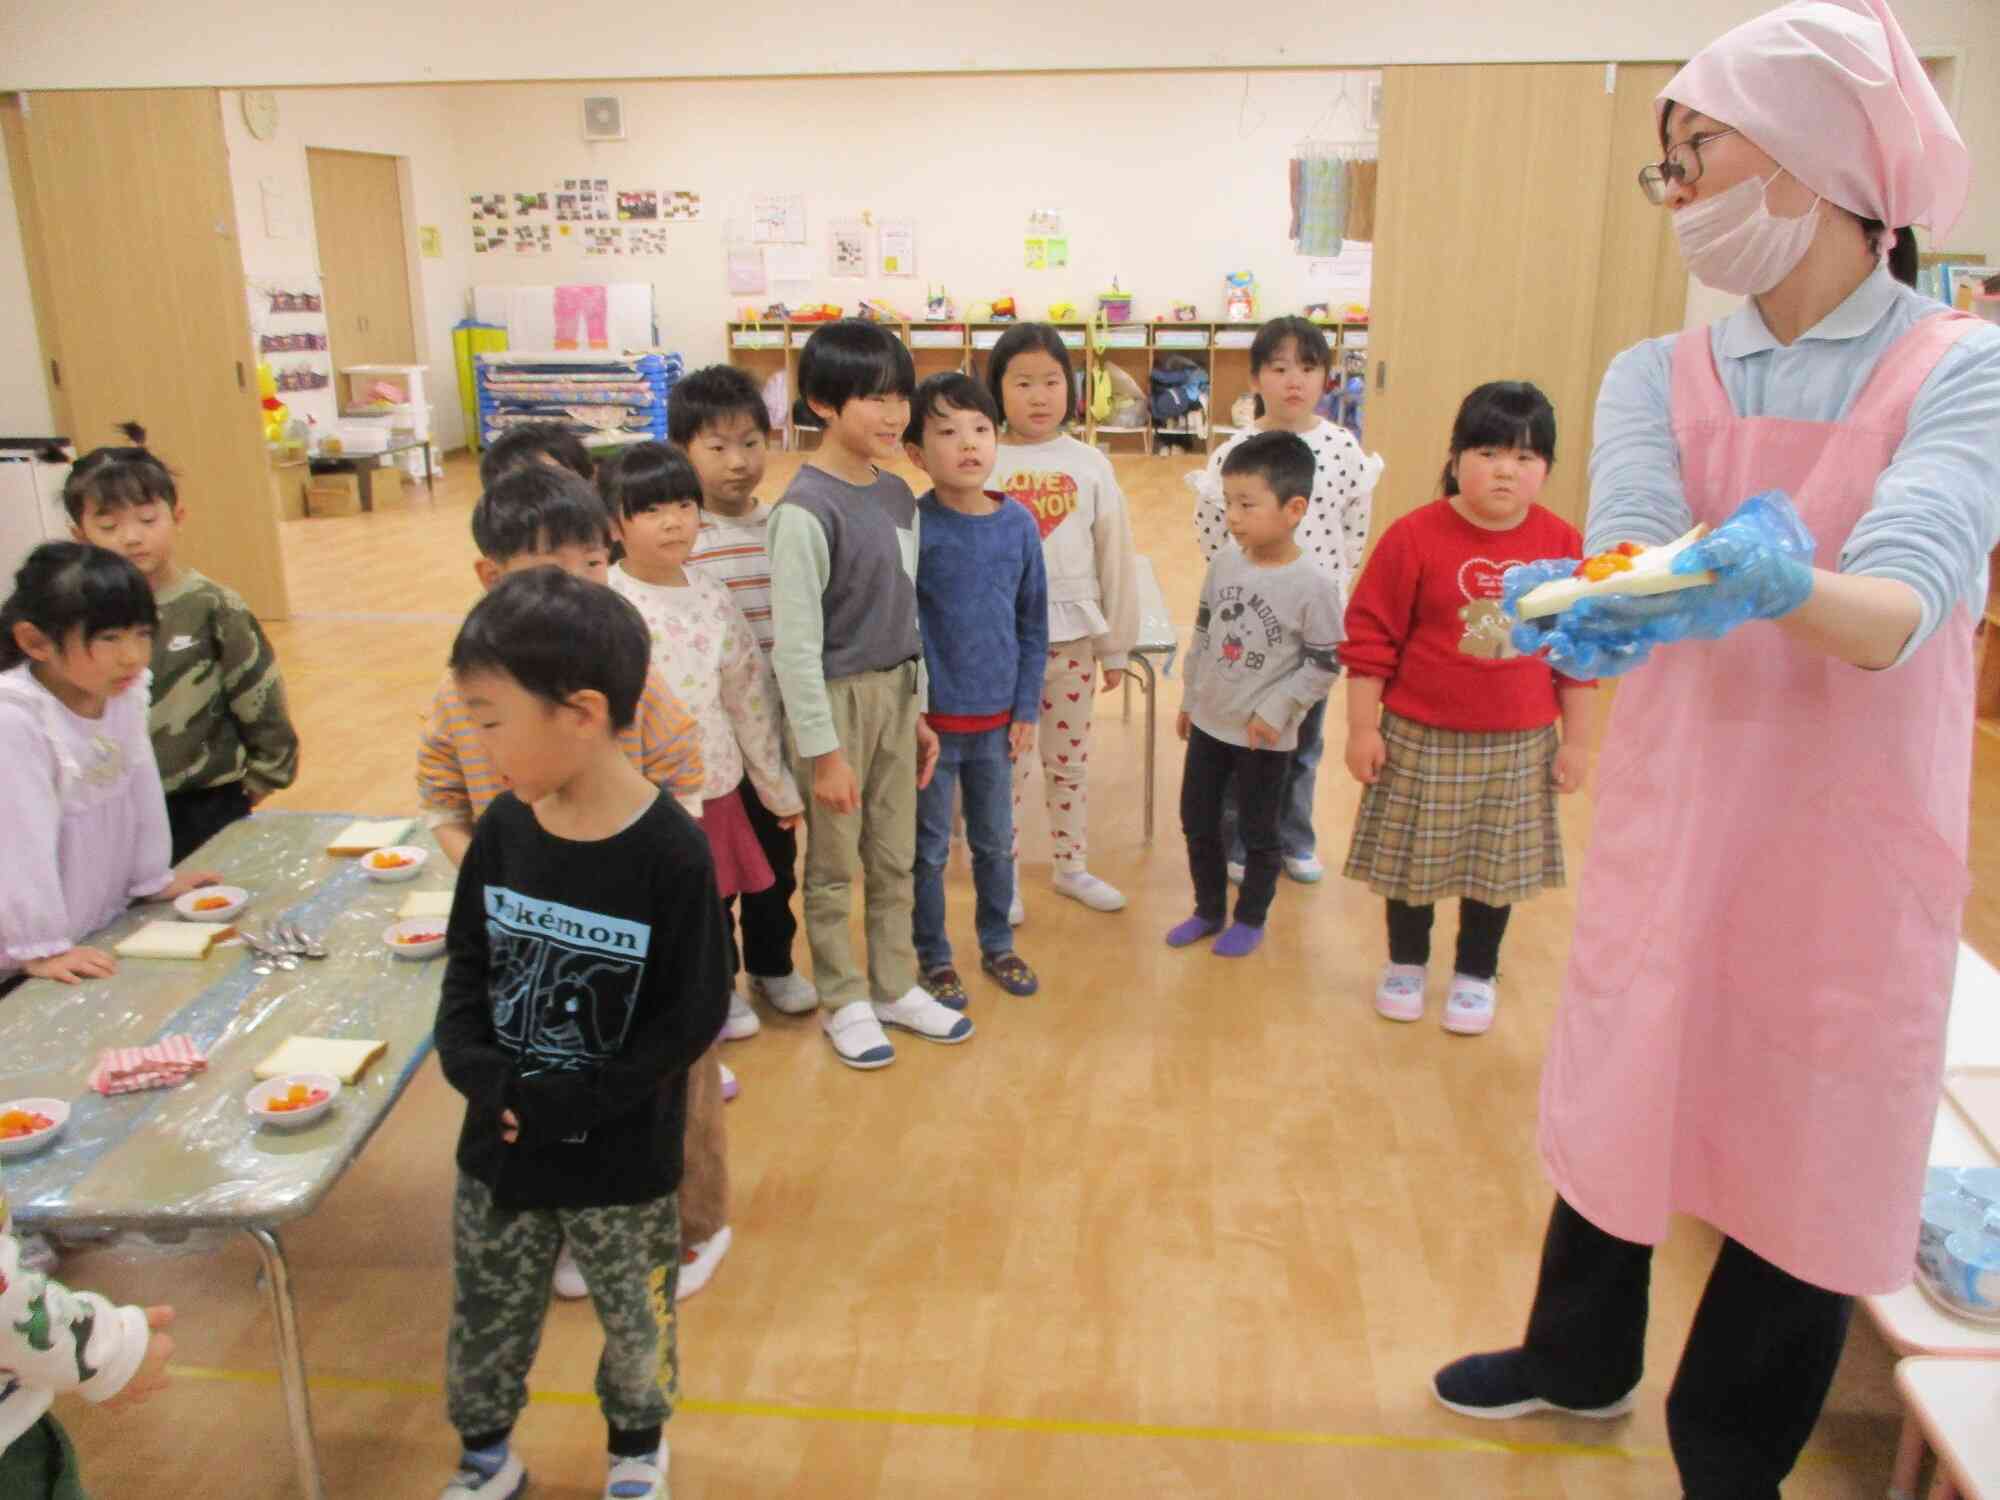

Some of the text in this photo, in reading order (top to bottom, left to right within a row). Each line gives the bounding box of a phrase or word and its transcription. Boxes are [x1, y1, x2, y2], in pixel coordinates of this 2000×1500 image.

[997, 470, 1062, 493] LOVE
[1032, 491, 1079, 520] YOU
[1247, 593, 1282, 648] MOUSE
